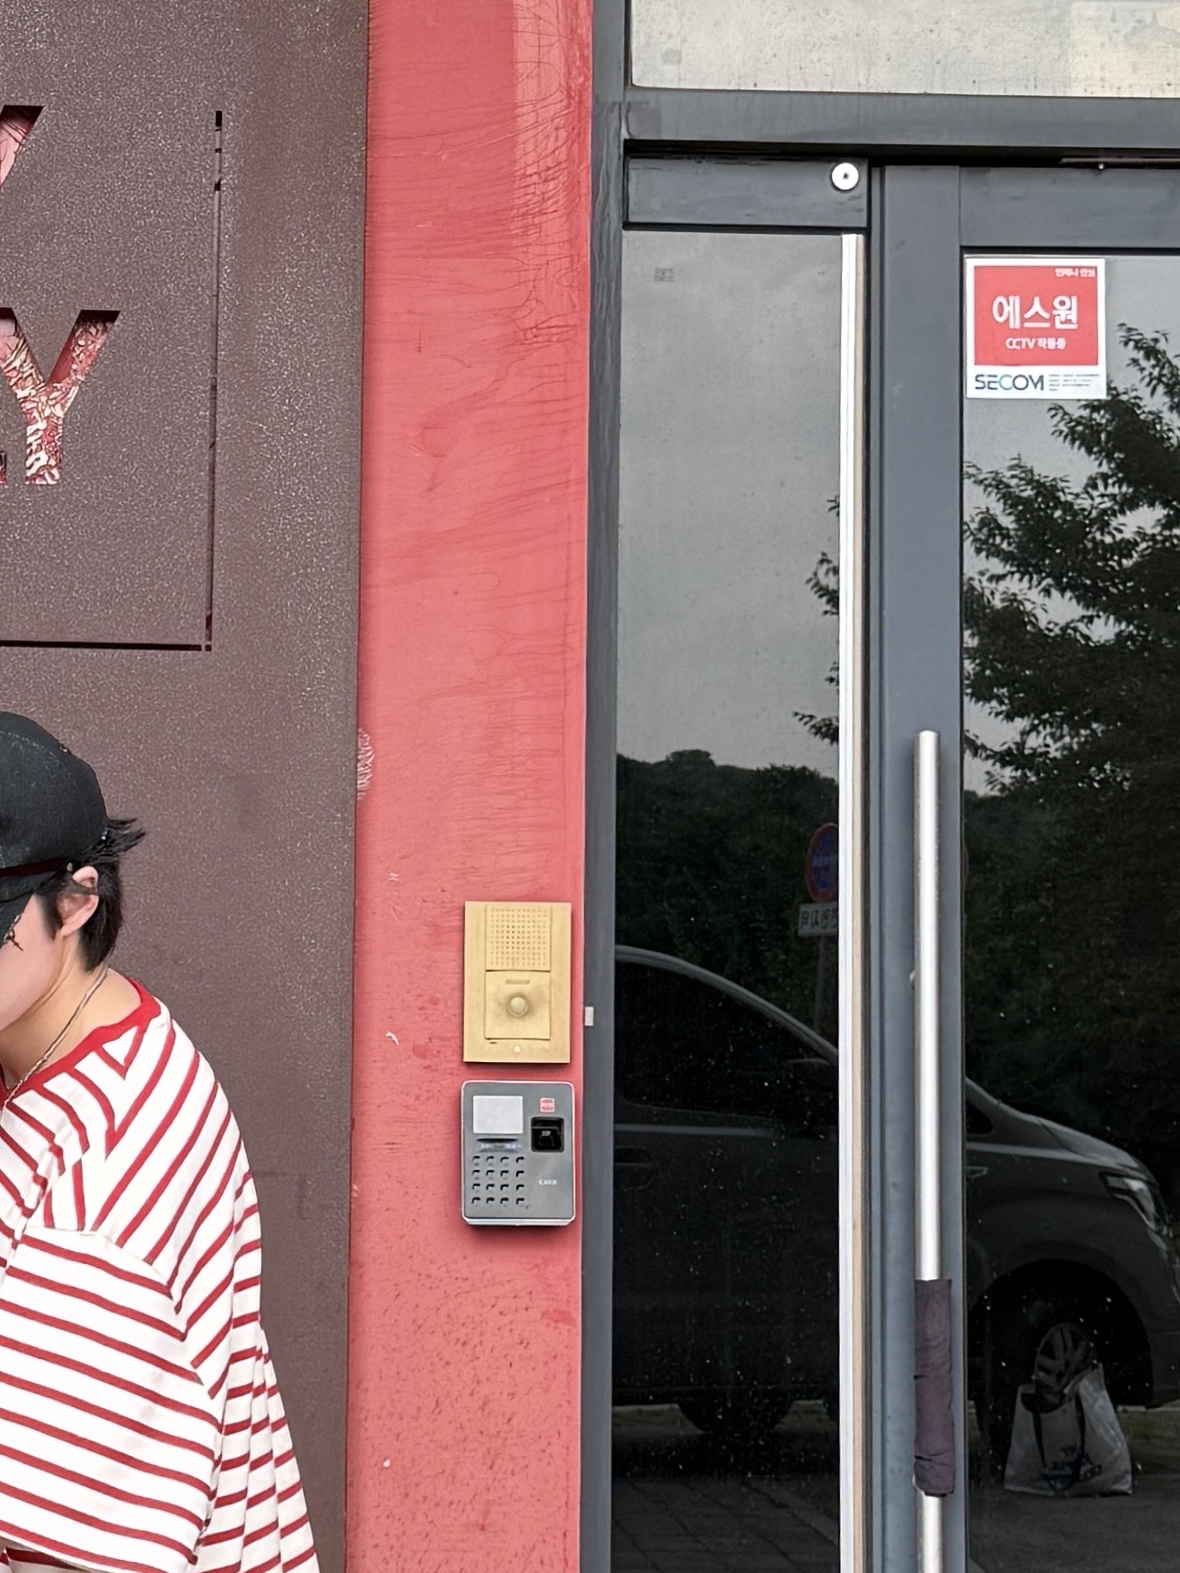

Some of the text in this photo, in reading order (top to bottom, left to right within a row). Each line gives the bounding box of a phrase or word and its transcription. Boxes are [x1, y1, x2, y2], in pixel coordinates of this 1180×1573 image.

[992, 295, 1079, 330] 에스원
[1005, 337, 1036, 350] CCTV
[975, 374, 1045, 391] SECOM
